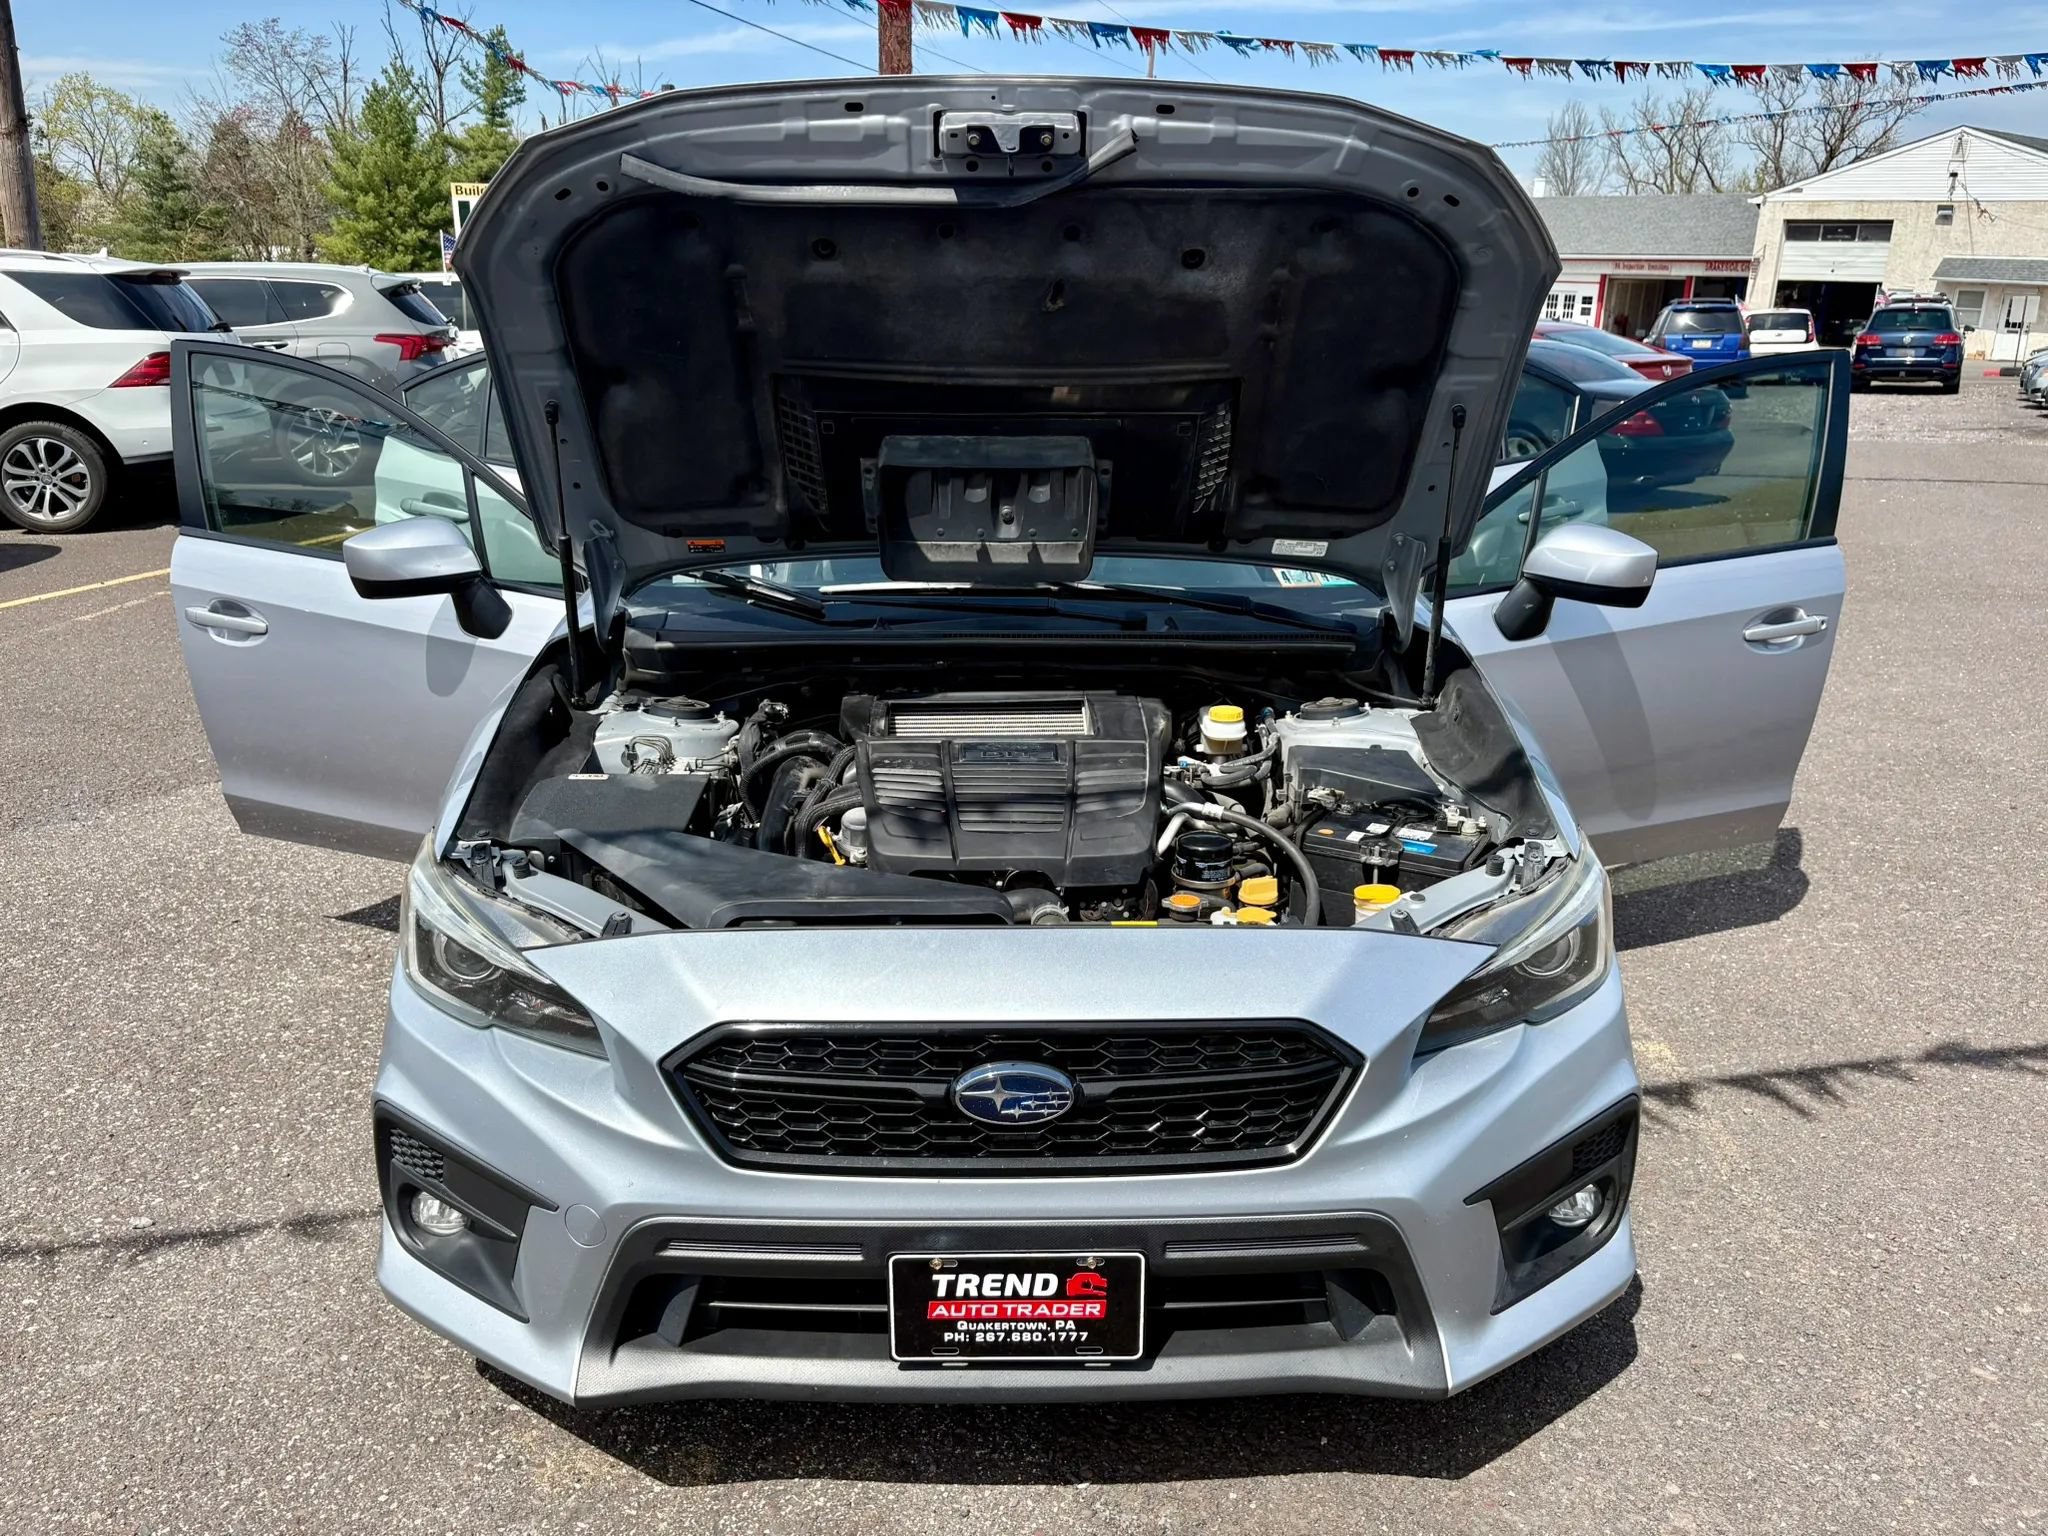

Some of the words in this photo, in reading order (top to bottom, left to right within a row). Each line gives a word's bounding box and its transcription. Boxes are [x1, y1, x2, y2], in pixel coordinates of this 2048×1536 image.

[932, 1273, 1059, 1297] TREND
[932, 1304, 998, 1317] AUTO
[1002, 1303, 1101, 1316] TRADER
[1055, 1320, 1076, 1330] PA
[944, 1332, 970, 1342] PH:
[975, 1332, 1089, 1342] 267.680.1777
